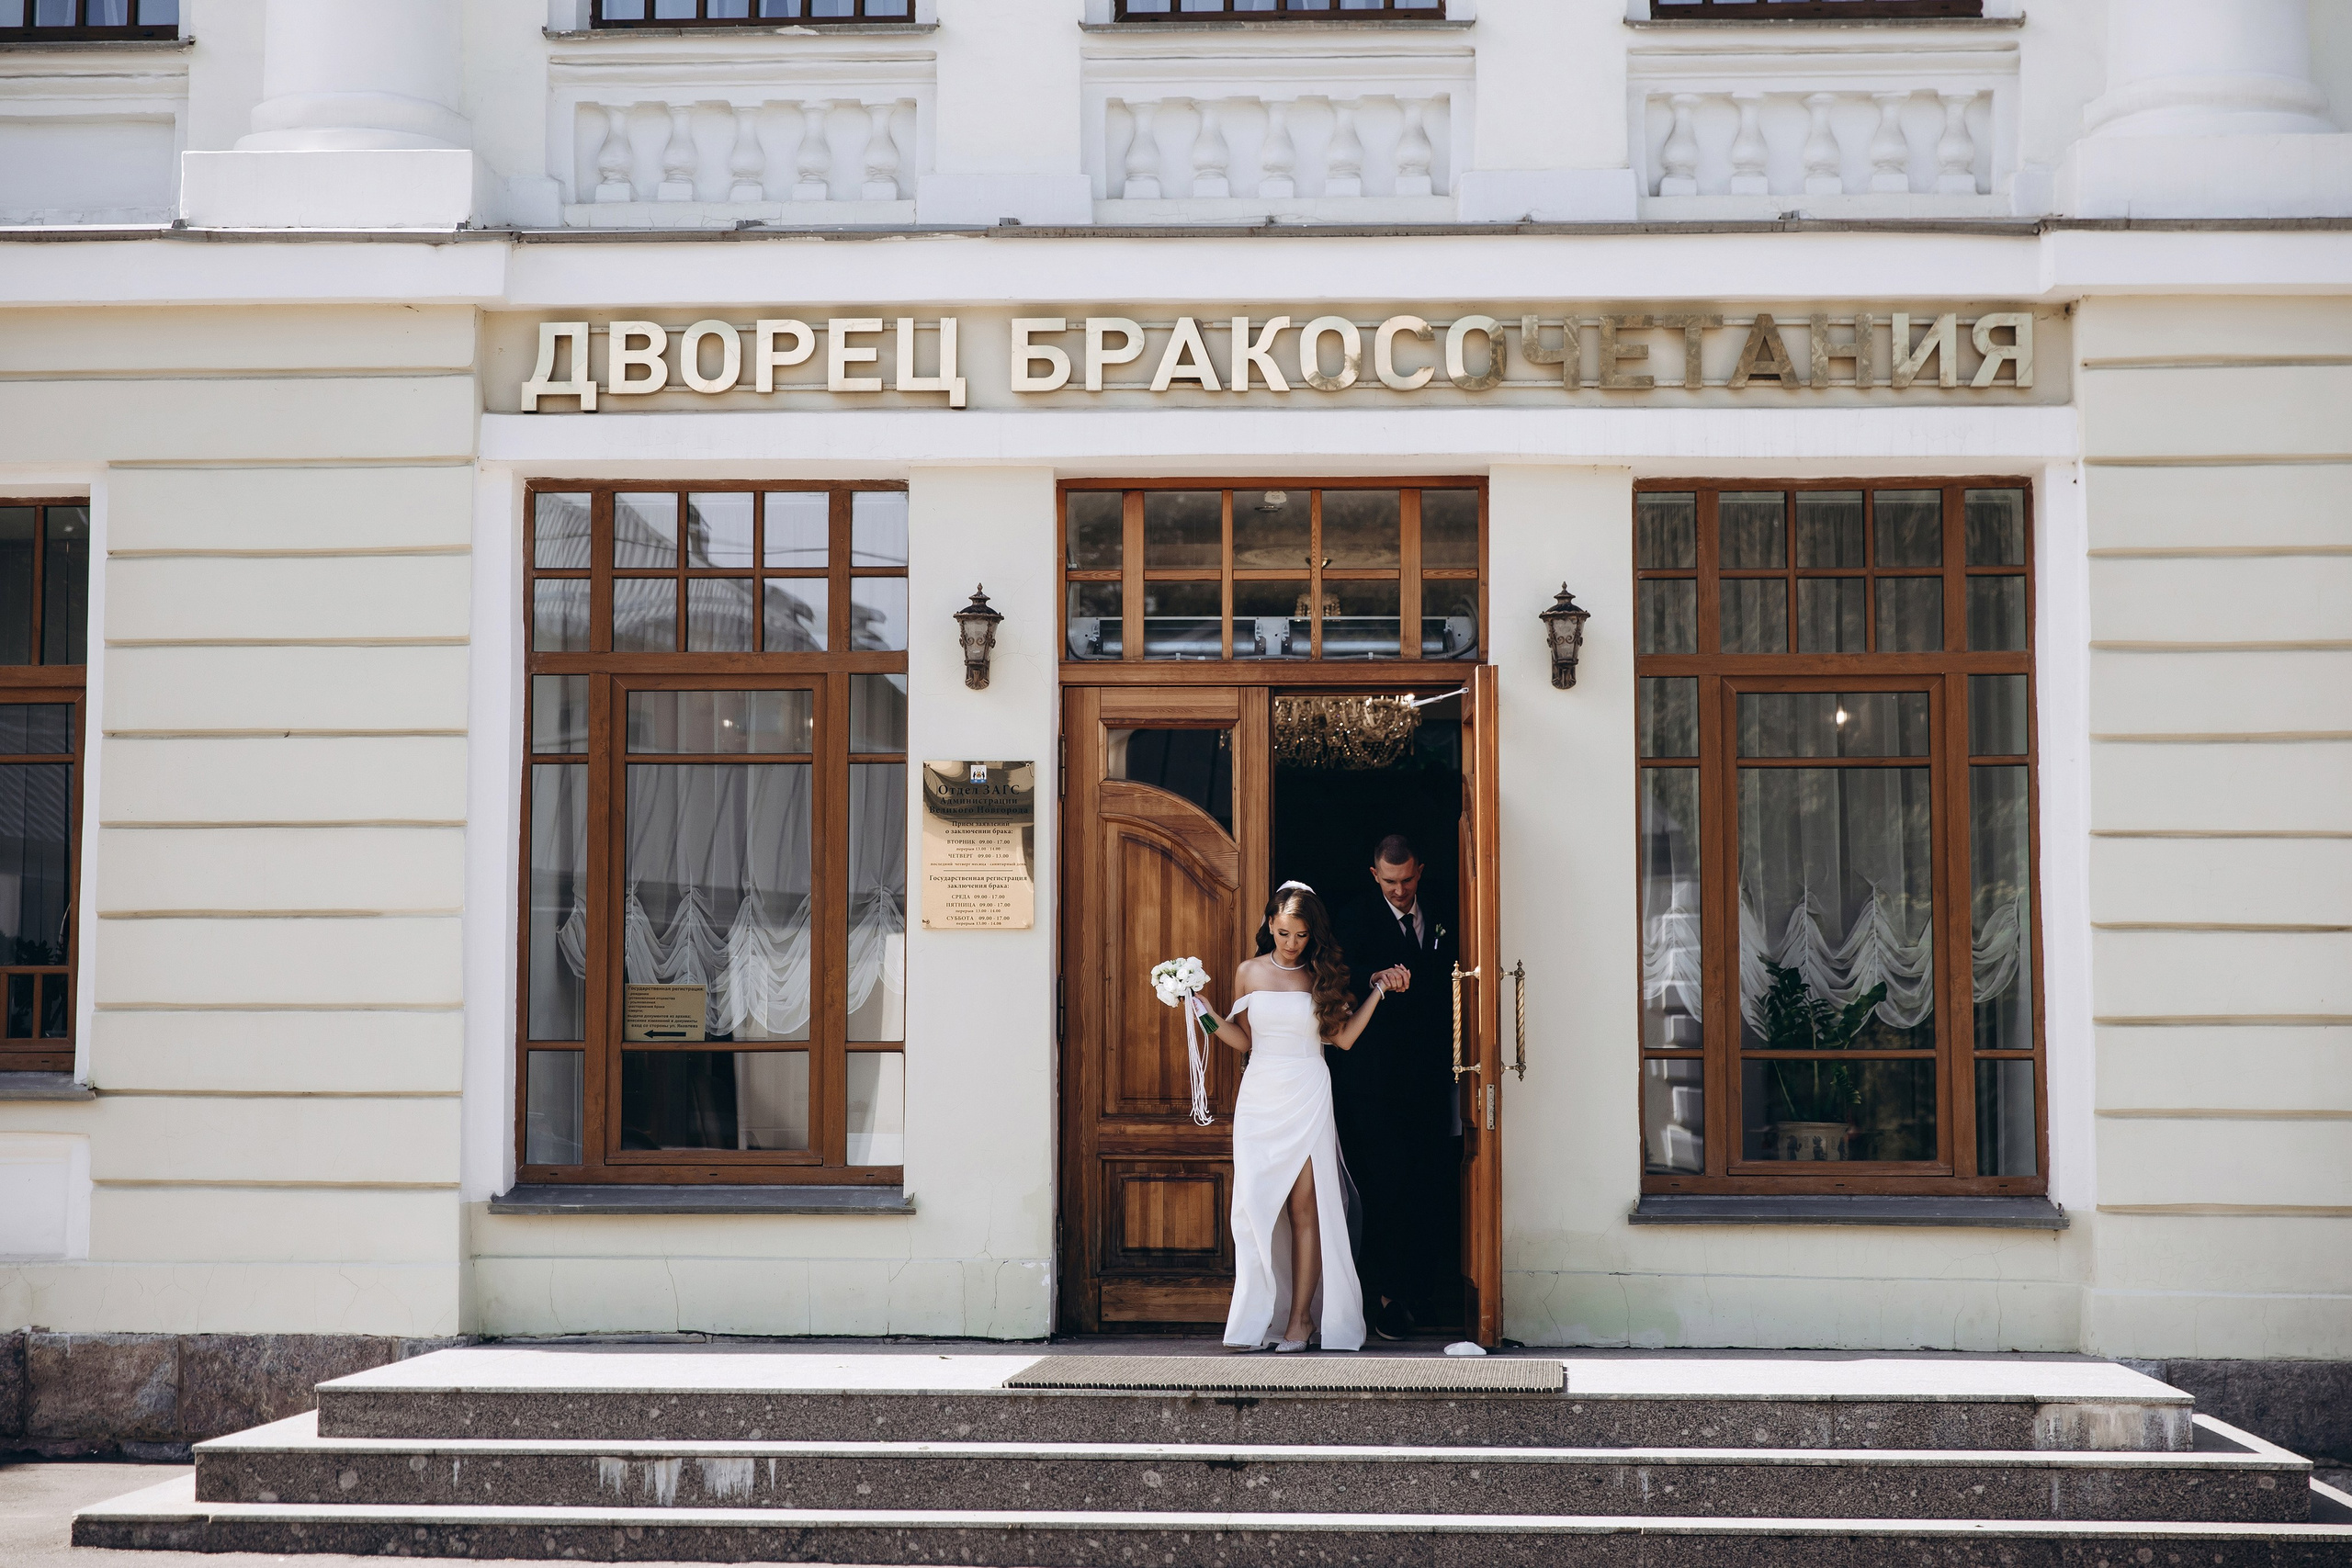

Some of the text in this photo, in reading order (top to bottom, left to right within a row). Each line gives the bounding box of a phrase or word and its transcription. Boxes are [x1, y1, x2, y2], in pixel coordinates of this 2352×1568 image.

[521, 312, 2033, 412] ДВОРЕЦ БРАКОСОЧЕТАНИЯ
[938, 784, 1020, 796] Отдел ЗАГС
[940, 797, 1018, 806] Администрации
[977, 807, 1028, 816] Новгорода
